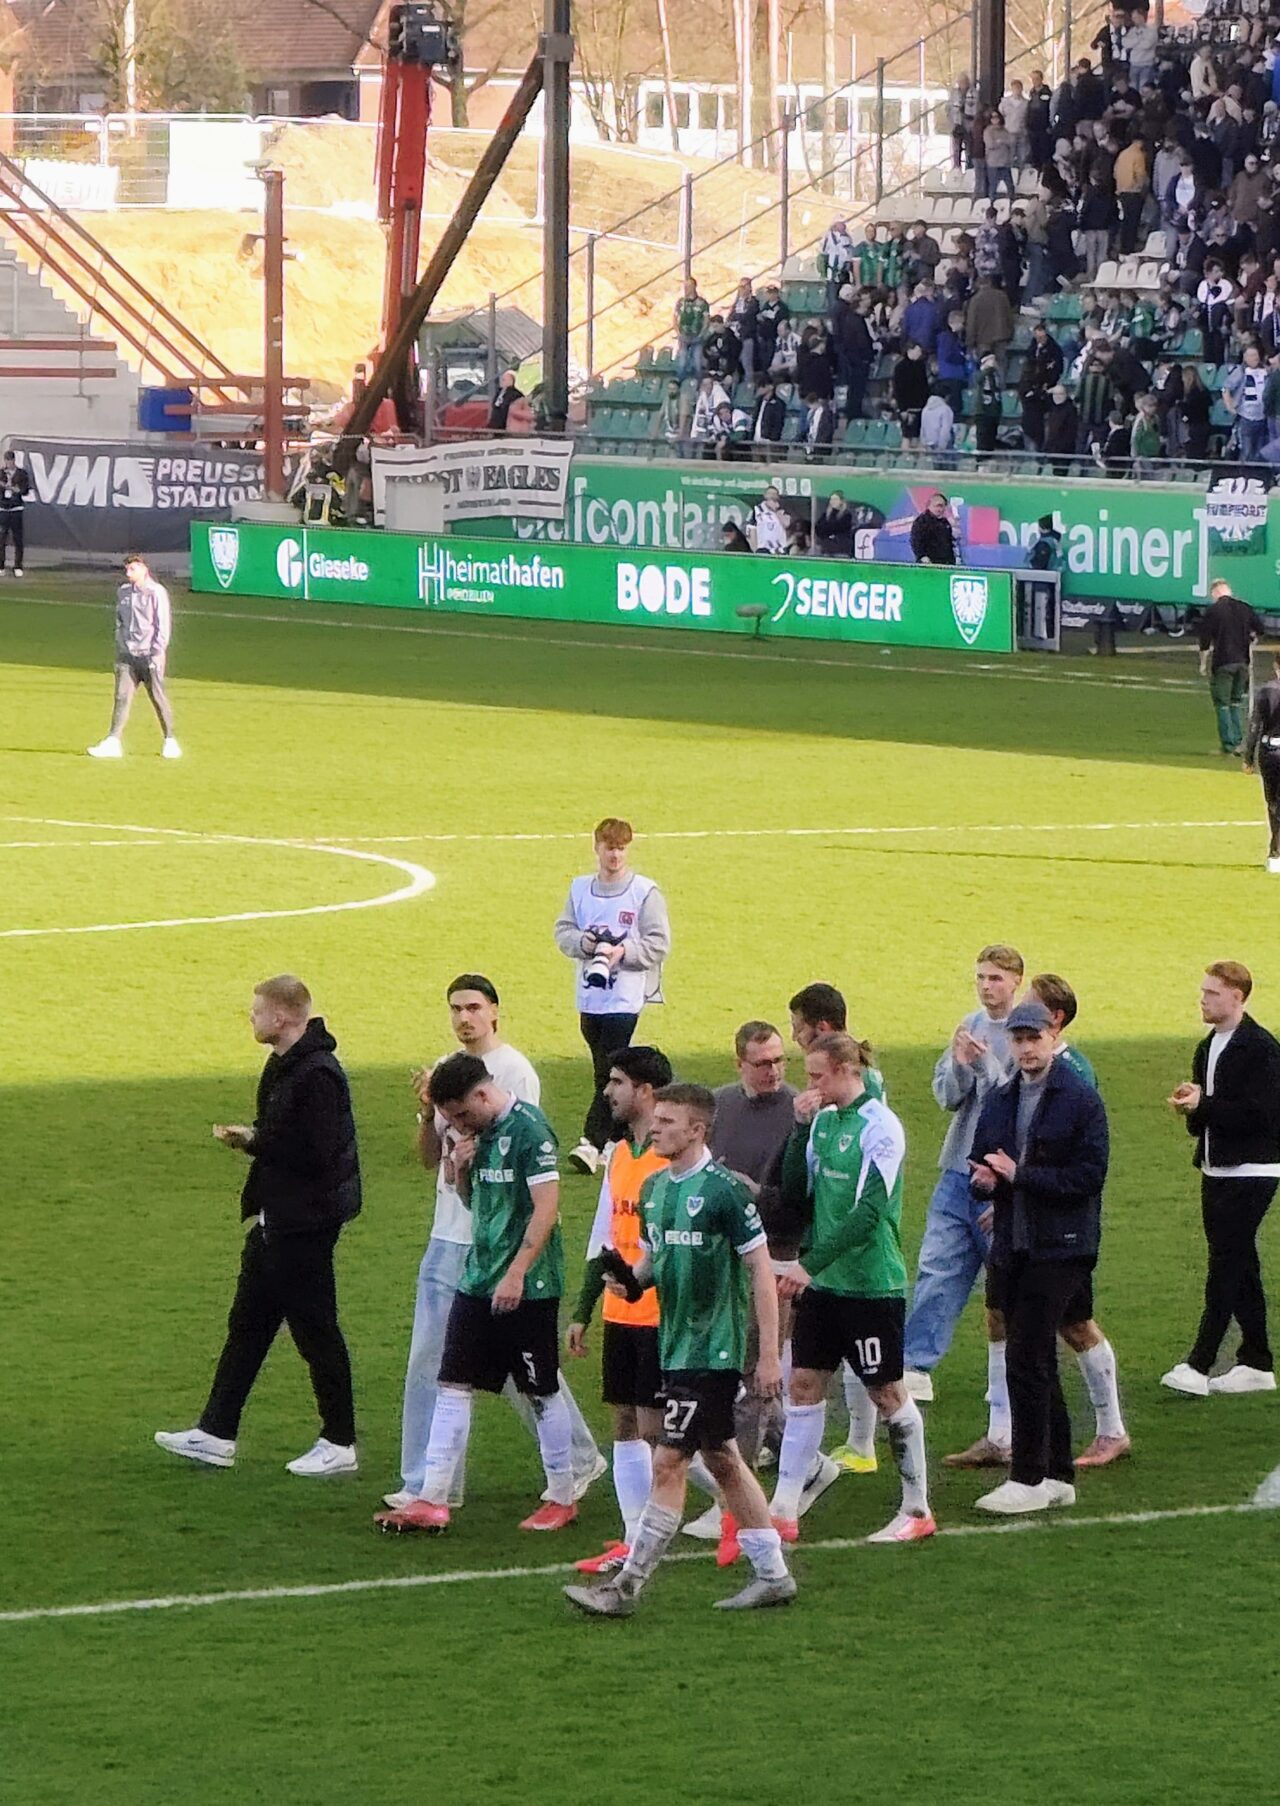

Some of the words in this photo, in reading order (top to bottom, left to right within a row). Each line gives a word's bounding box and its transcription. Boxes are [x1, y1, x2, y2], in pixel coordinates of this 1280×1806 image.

[157, 458, 292, 484] PREUSS
[483, 465, 561, 491] EAGLES
[309, 552, 369, 582] Gieseke
[446, 554, 564, 589] heimathafen
[617, 562, 711, 616] BODE
[796, 577, 903, 622] SENGER
[855, 1336, 882, 1368] 10
[663, 1399, 698, 1432] 27
